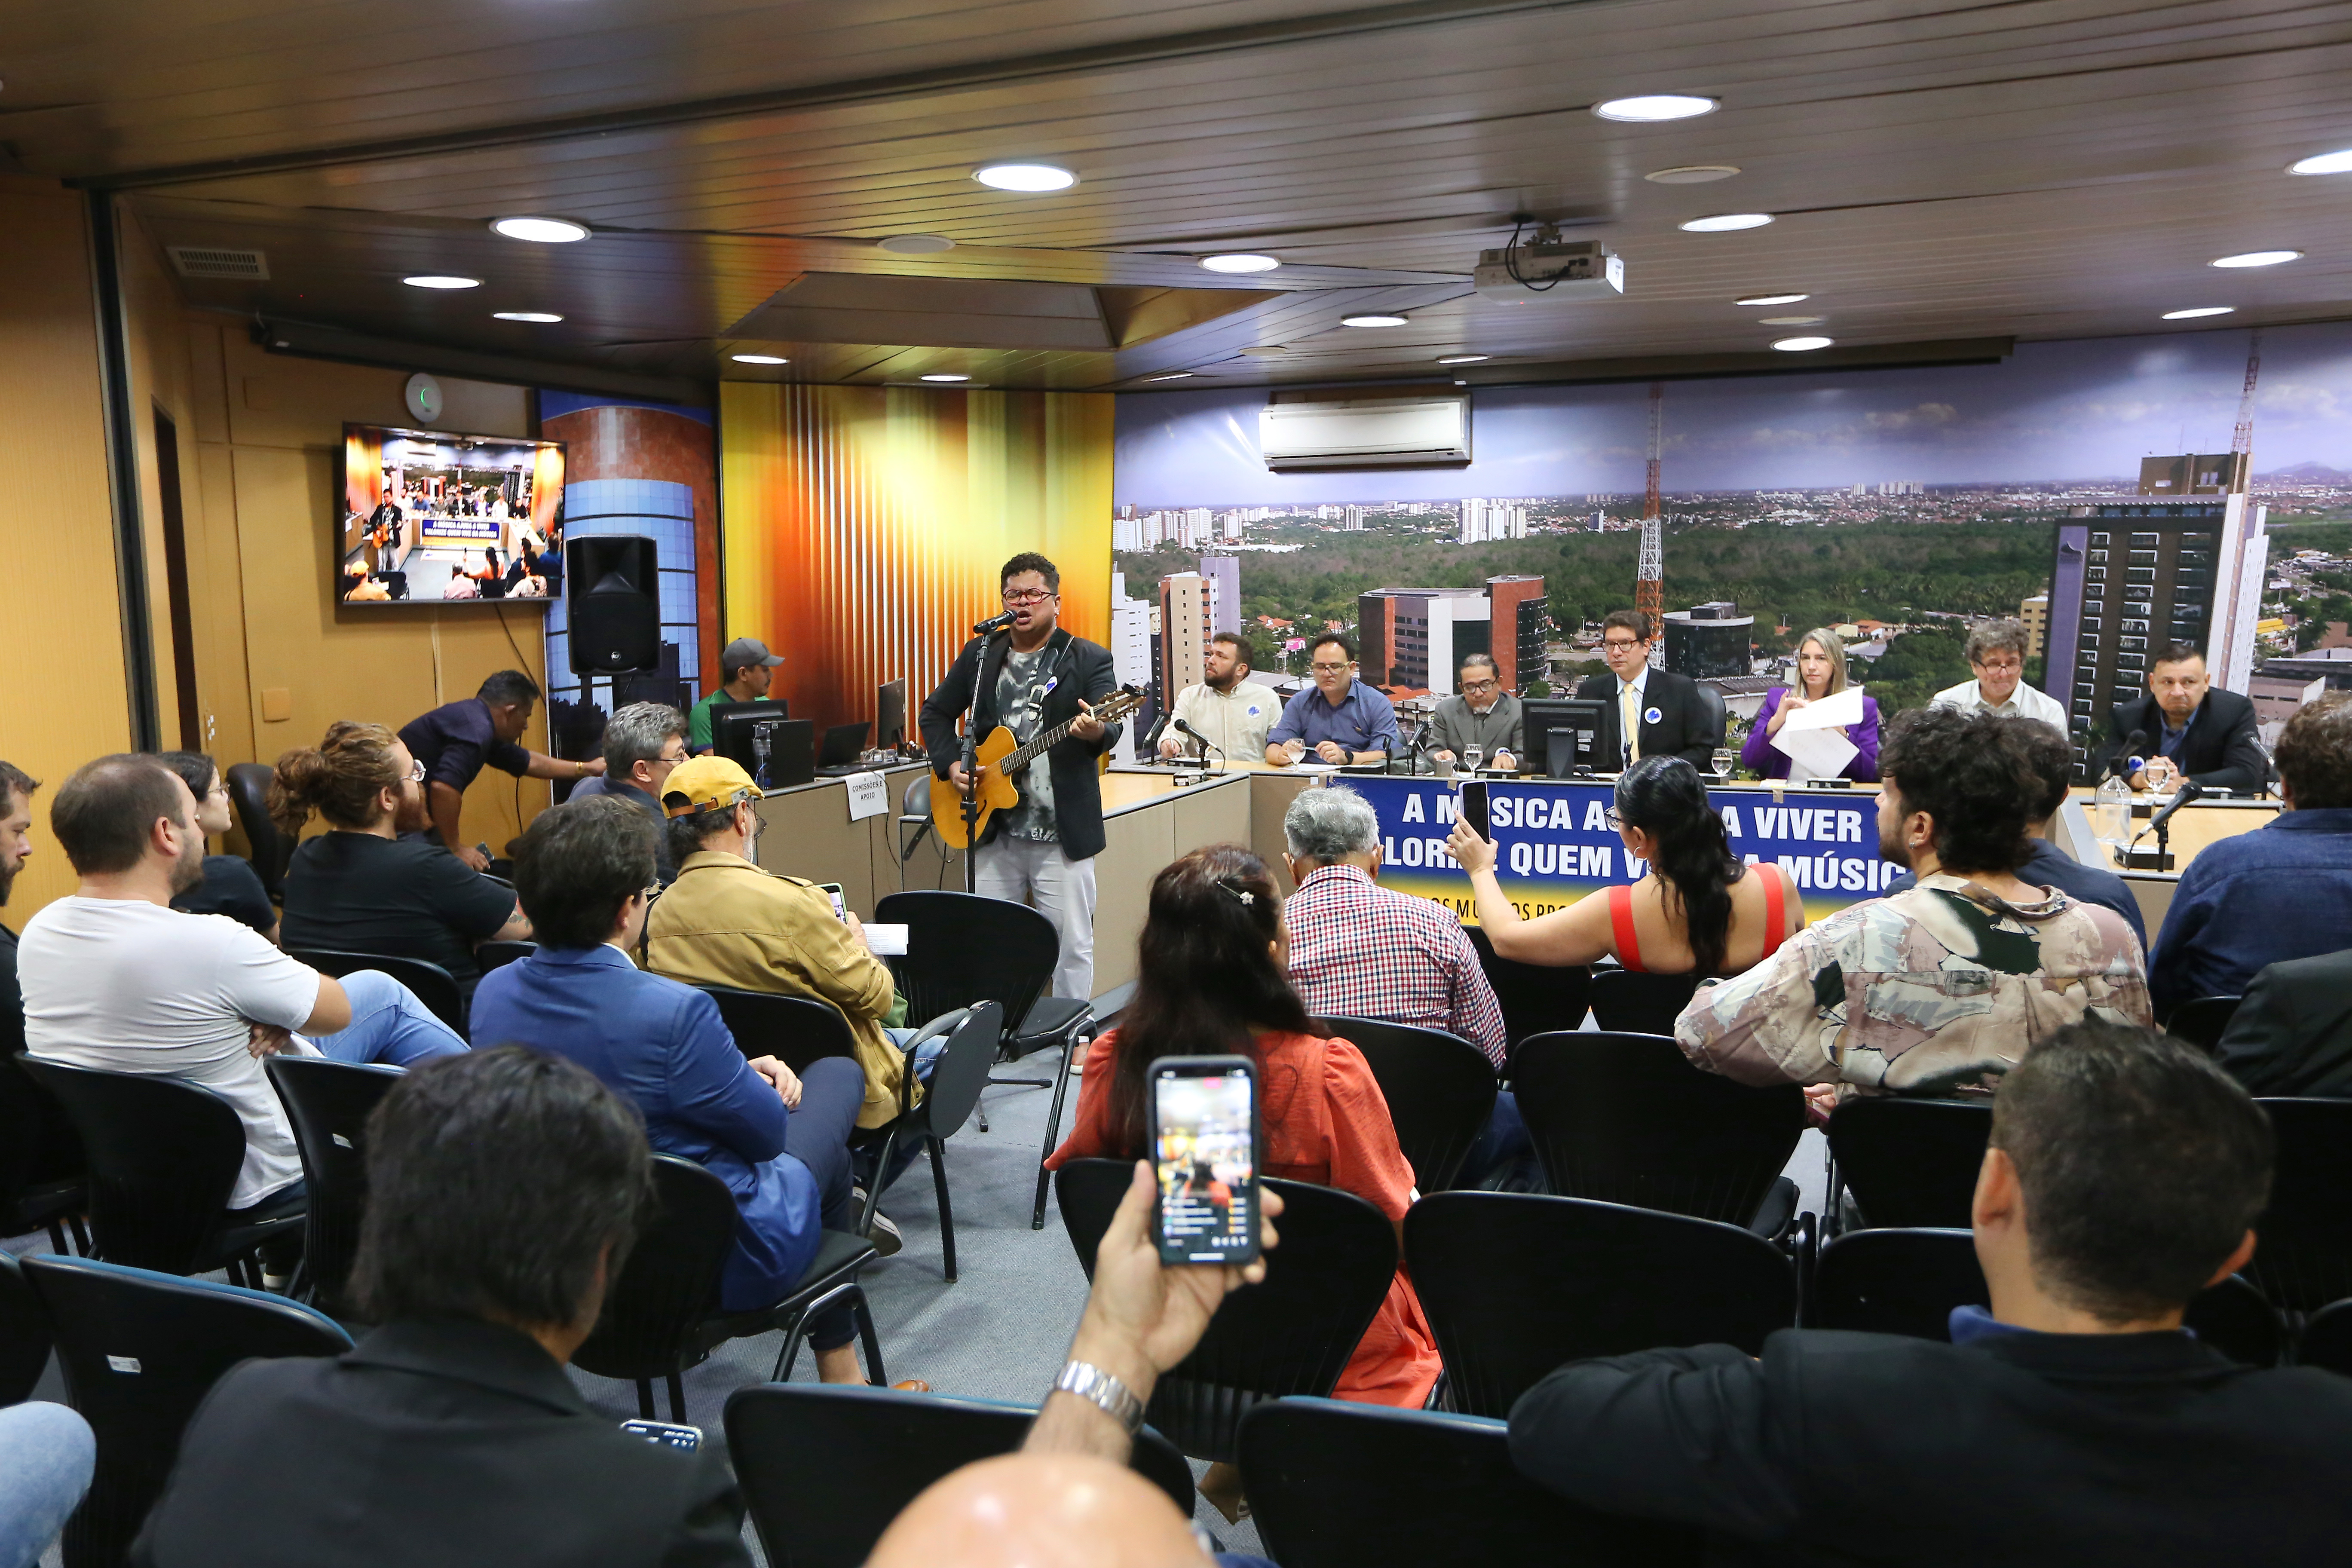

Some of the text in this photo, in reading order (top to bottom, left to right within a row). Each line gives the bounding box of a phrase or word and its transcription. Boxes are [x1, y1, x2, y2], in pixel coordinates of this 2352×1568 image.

[852, 781, 879, 792] COMISSÕES
[1402, 793, 1425, 823] A
[1436, 794, 1573, 830] MSICA
[1753, 806, 1862, 843] VIVER
[1510, 842, 1611, 877] QUEM
[1777, 850, 1906, 892] MÚSIC
